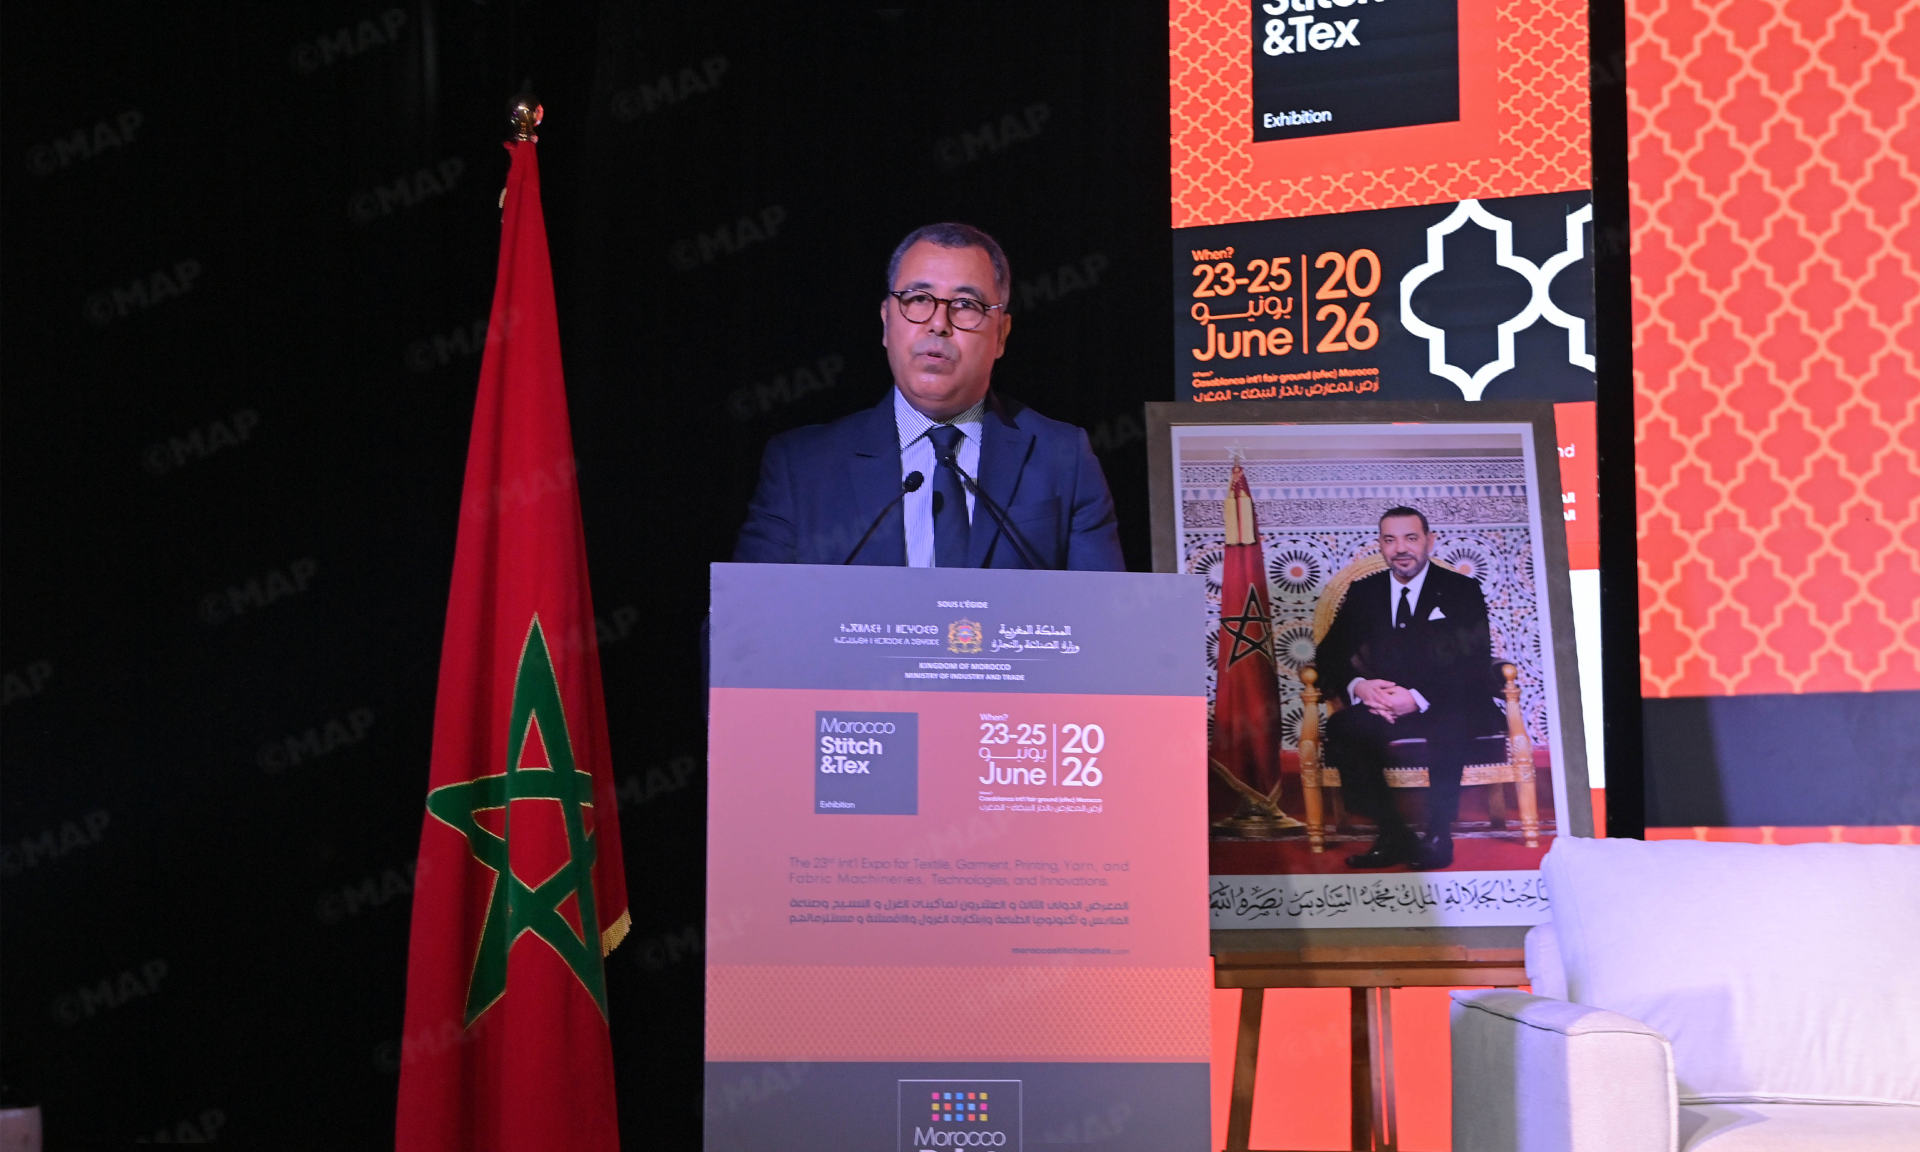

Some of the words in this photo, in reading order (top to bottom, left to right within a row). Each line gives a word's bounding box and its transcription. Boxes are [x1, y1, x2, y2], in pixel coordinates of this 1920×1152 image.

[1262, 15, 1361, 57] &Tex
[1263, 109, 1333, 129] Exhibition
[1191, 246, 1235, 261] When?
[1192, 257, 1292, 298] 23-25
[1315, 248, 1381, 300] 20
[1316, 302, 1380, 353] 26
[1192, 323, 1294, 361] June
[1191, 376, 1246, 388] Casablanca
[1263, 373, 1279, 383] fair
[1279, 371, 1312, 384] ground
[1338, 367, 1380, 378] Morocco
[937, 600, 958, 608] SOUS
[959, 599, 988, 609] L'ÉGIDE
[918, 662, 957, 670] KINGDOM
[971, 663, 1012, 671] MOROCCO
[820, 717, 896, 734] Morocco
[979, 713, 1009, 721] When?
[979, 722, 1047, 745] 23-25
[1061, 723, 1105, 754] 20
[820, 736, 883, 755] Stitch
[820, 755, 870, 774] &Tex
[978, 761, 1047, 786] June
[1061, 756, 1103, 787] 26
[820, 800, 856, 809] Exhibition
[789, 857, 811, 869] The
[861, 858, 891, 871] Expo
[893, 858, 911, 869] for
[912, 858, 953, 872] Textile,
[956, 859, 1012, 872] Garment,
[1015, 860, 1060, 873] Printing,
[1063, 860, 1098, 873] Yarn,
[1103, 861, 1130, 872] and
[789, 872, 832, 884] Fabric
[837, 873, 926, 886] Machineries,
[931, 874, 1010, 887] Technologies,
[1013, 876, 1037, 886] and
[1040, 876, 1110, 887] Innovations.
[1011, 946, 1130, 955] moroccostitchandtex.com
[914, 1126, 1006, 1147] Morocco
